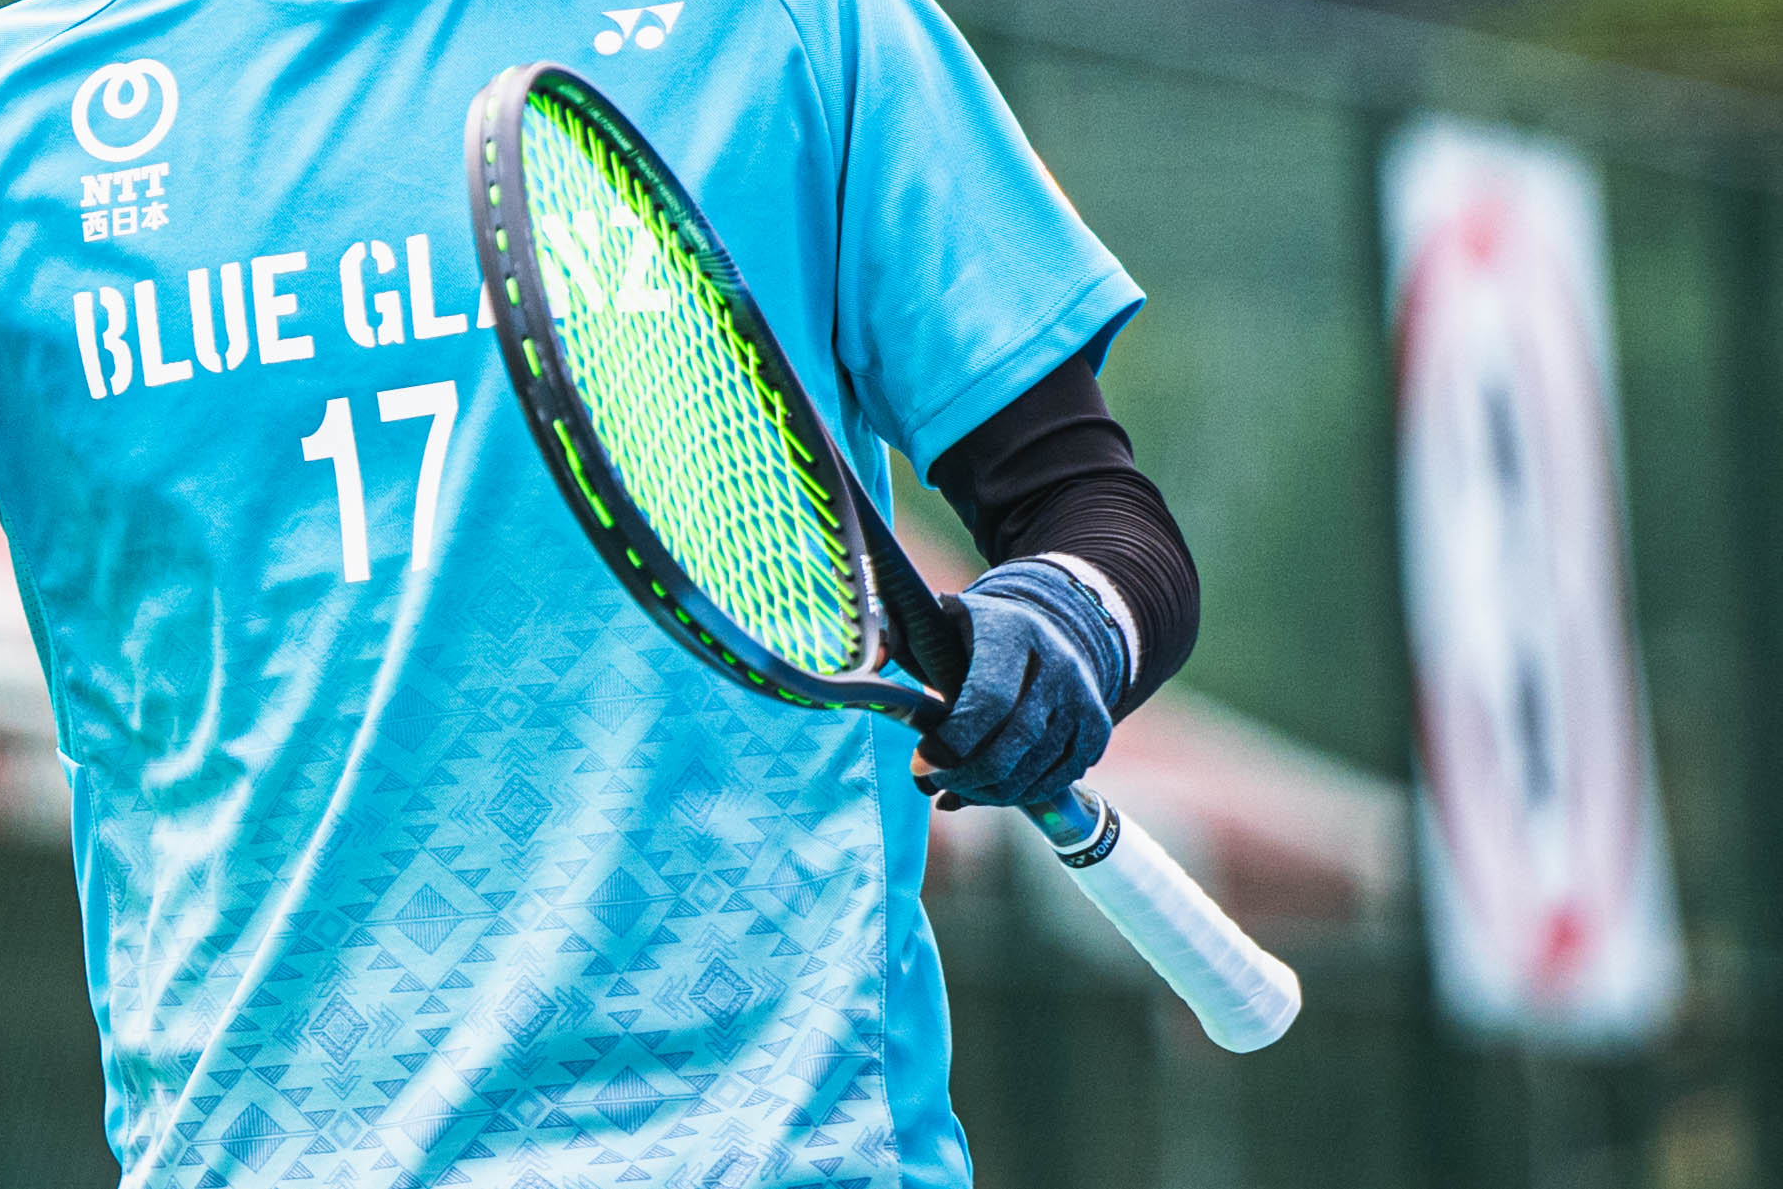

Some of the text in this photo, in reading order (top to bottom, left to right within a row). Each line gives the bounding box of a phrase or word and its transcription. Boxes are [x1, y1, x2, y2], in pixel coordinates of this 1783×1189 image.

[80, 162, 170, 208] NTT
[81, 201, 170, 243] 西日本
[73, 206, 672, 399] BLUE GLNZ
[300, 380, 459, 583] 17
[1088, 819, 1118, 859] YONEX
